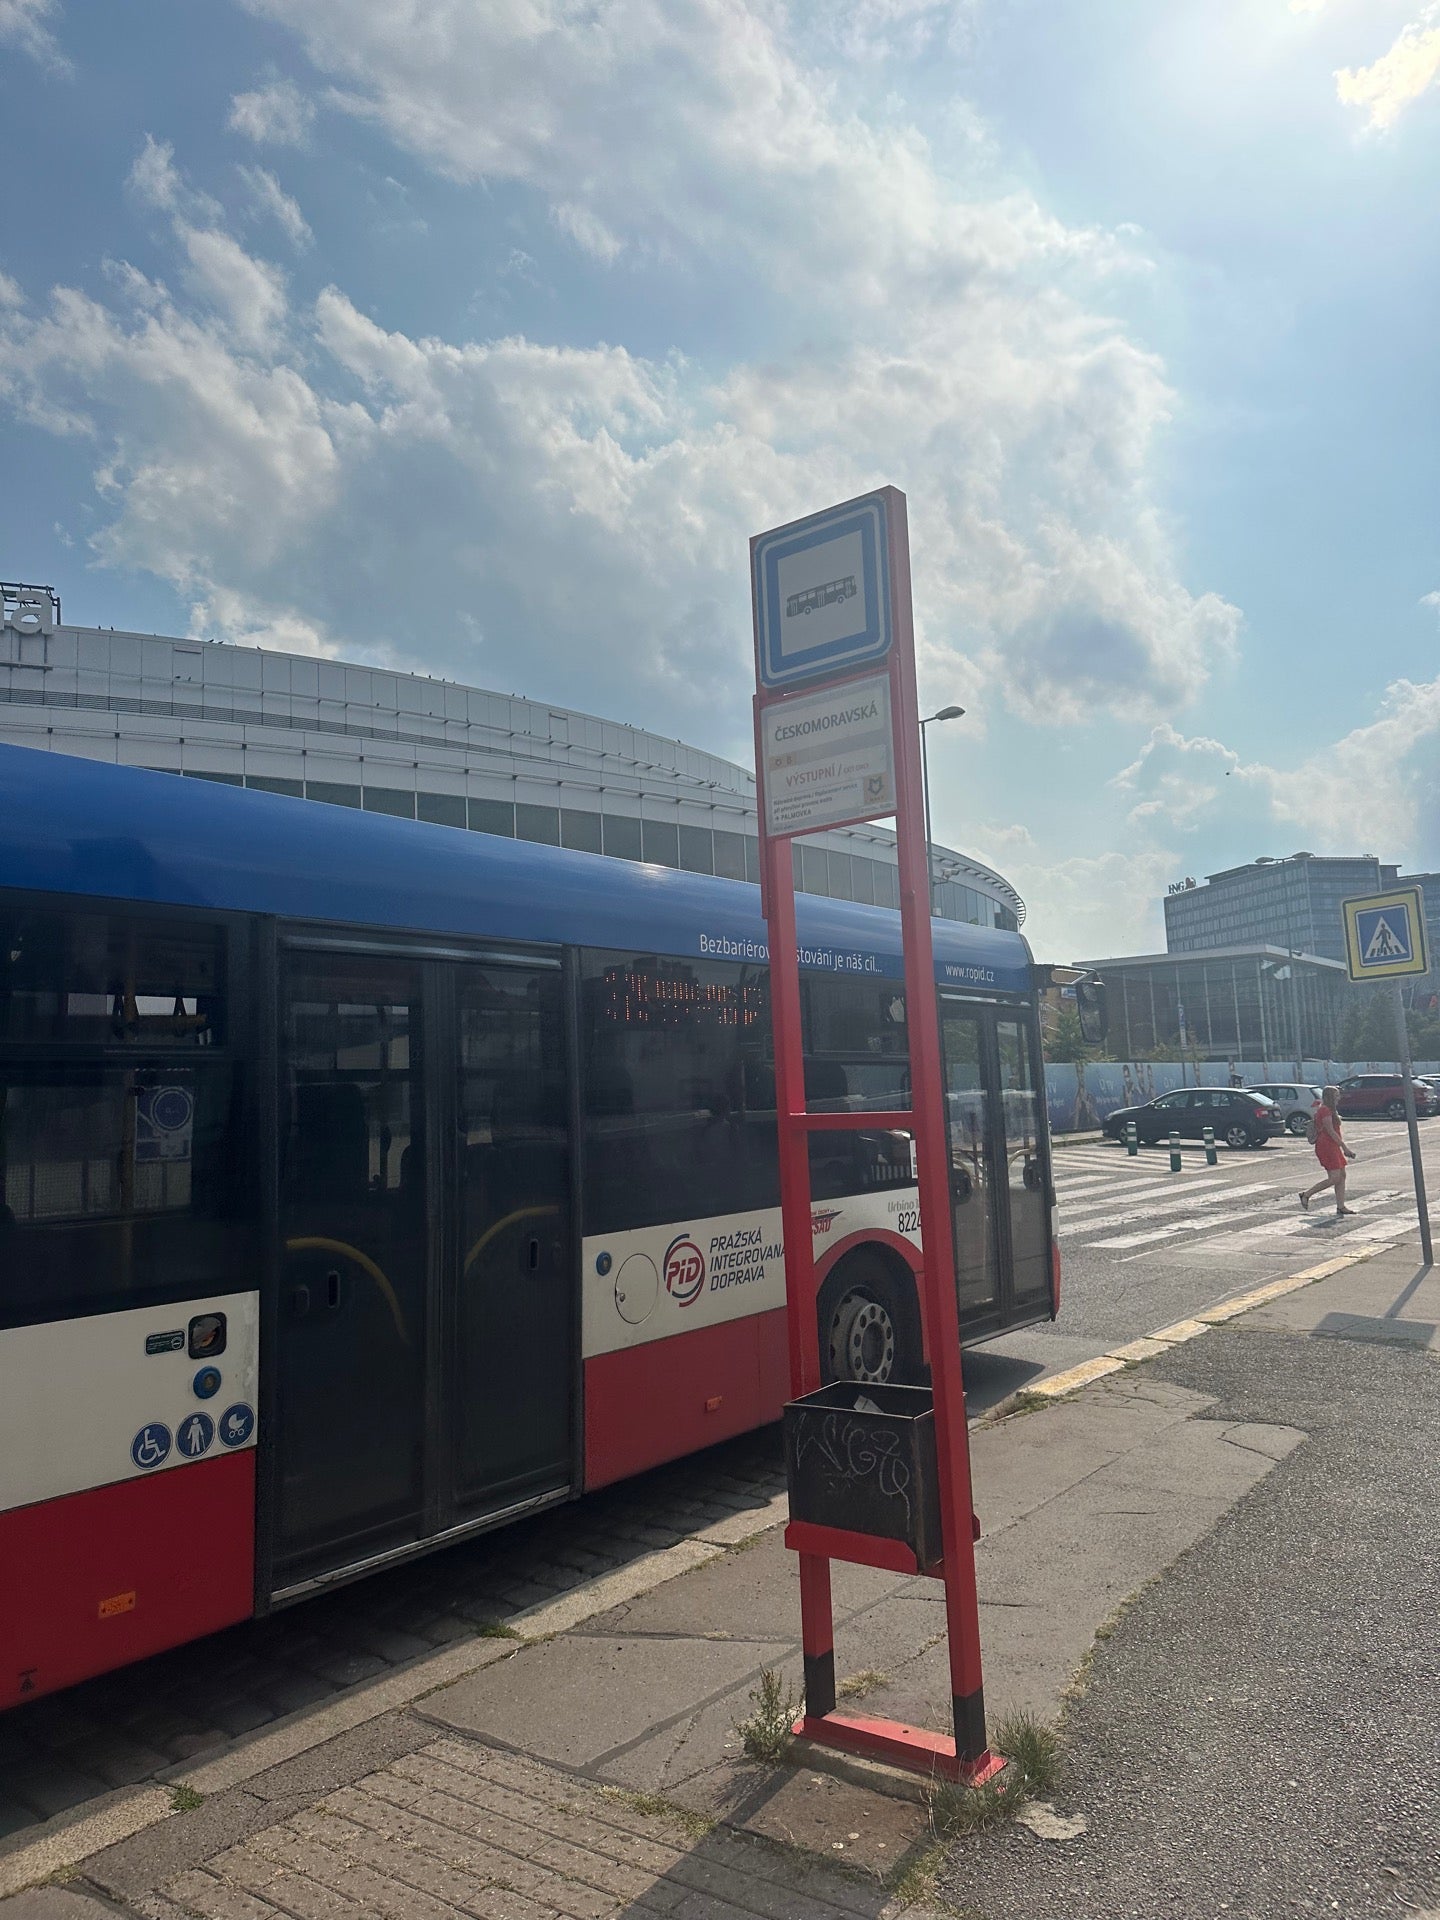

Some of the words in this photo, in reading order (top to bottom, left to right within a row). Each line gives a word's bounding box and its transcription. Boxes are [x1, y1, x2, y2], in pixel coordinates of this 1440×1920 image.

[774, 700, 879, 742] ČESKOMORAVSKÁ
[785, 764, 836, 787] VÝSTUPNÍ
[781, 808, 812, 821] PALMOVKA
[1168, 881, 1185, 895] ING
[700, 933, 770, 960] Bezbariérov
[796, 947, 832, 967] stování
[833, 955, 843, 972] je
[846, 953, 863, 970] náš
[945, 965, 995, 983] www.ropid.cz
[887, 1200, 915, 1213] Urbino
[709, 1226, 762, 1254] PRAŽSKÁ
[710, 1265, 765, 1292] DOPRAVA
